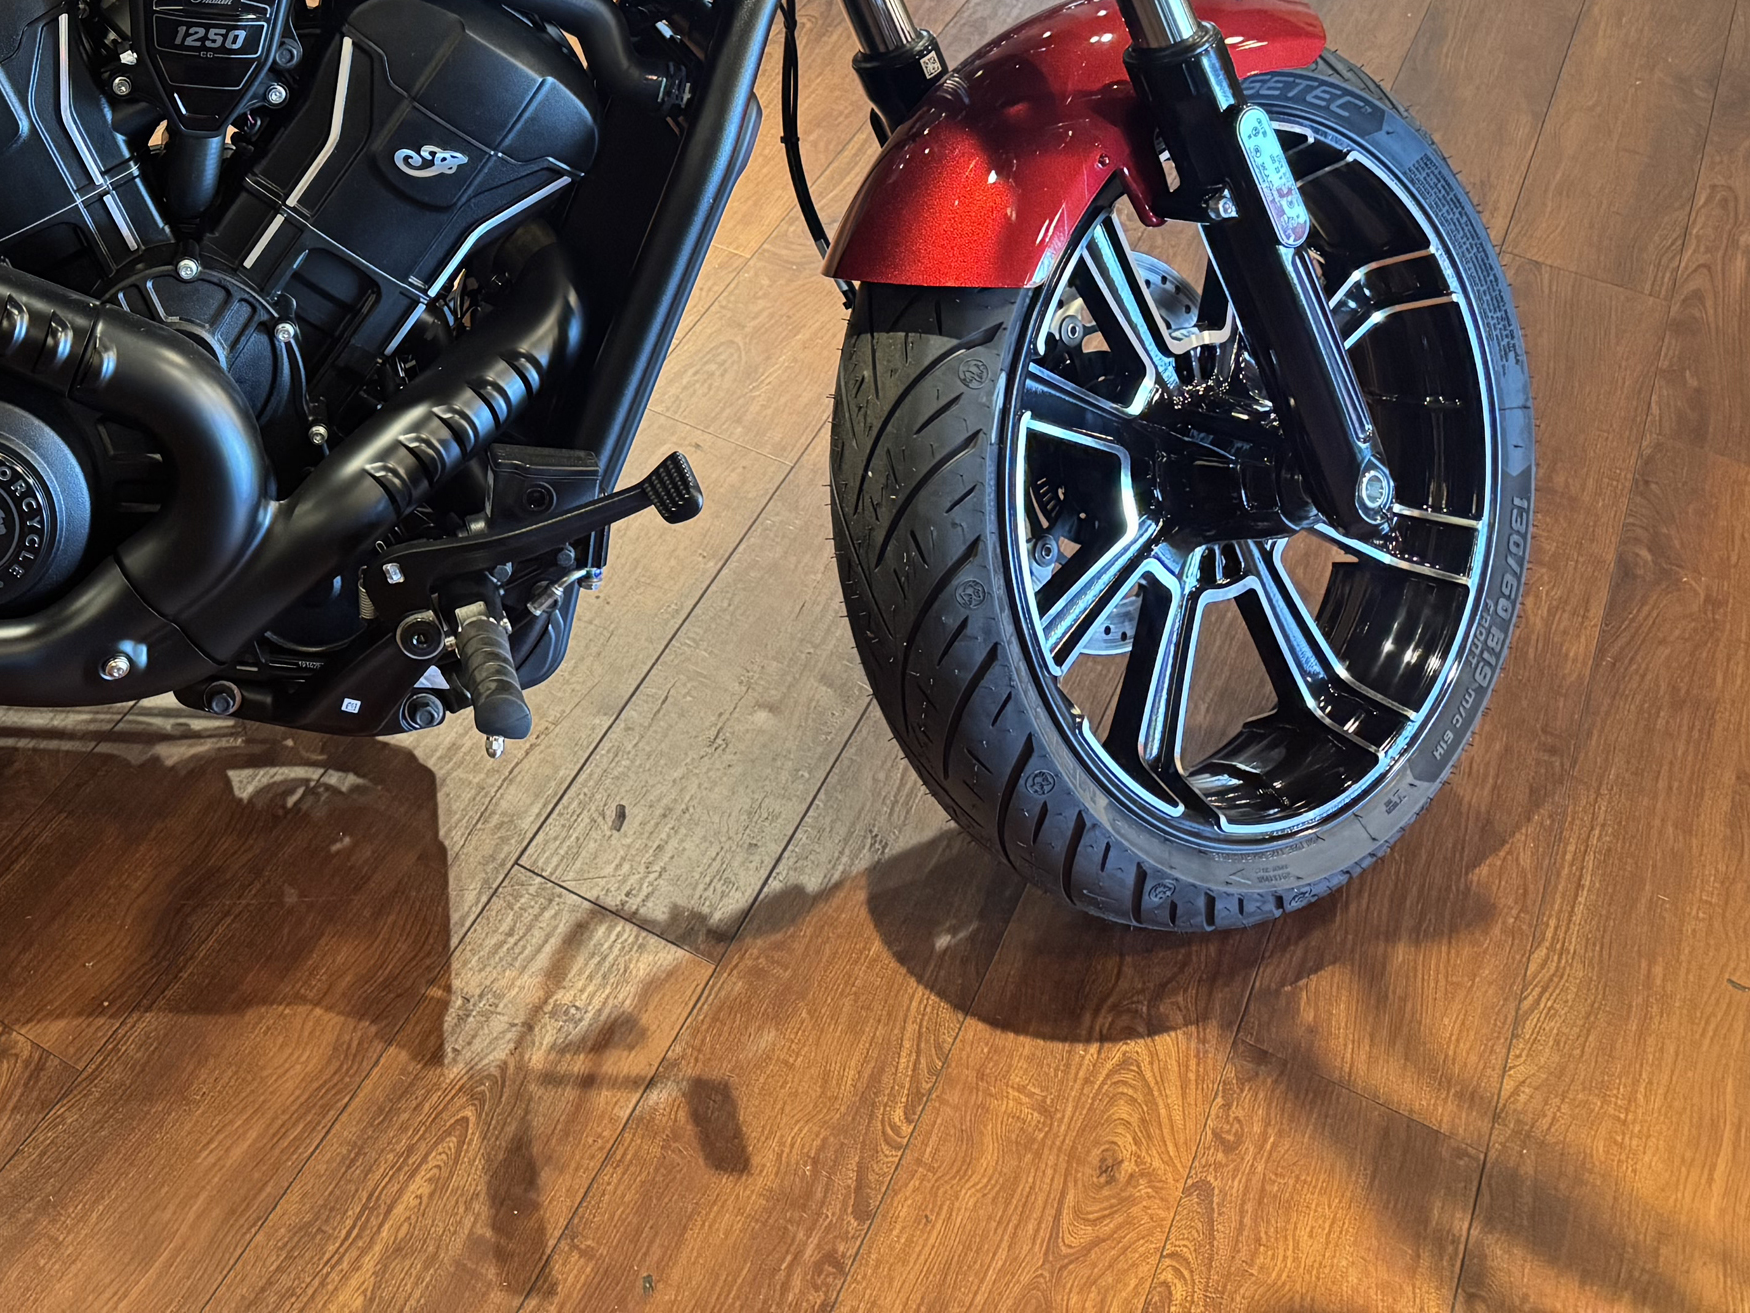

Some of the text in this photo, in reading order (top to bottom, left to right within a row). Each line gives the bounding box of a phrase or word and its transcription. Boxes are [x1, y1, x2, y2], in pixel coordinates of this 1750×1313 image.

[173, 25, 248, 50] 1250
[1495, 495, 1529, 622] 130/60
[1467, 597, 1495, 670] FRONT
